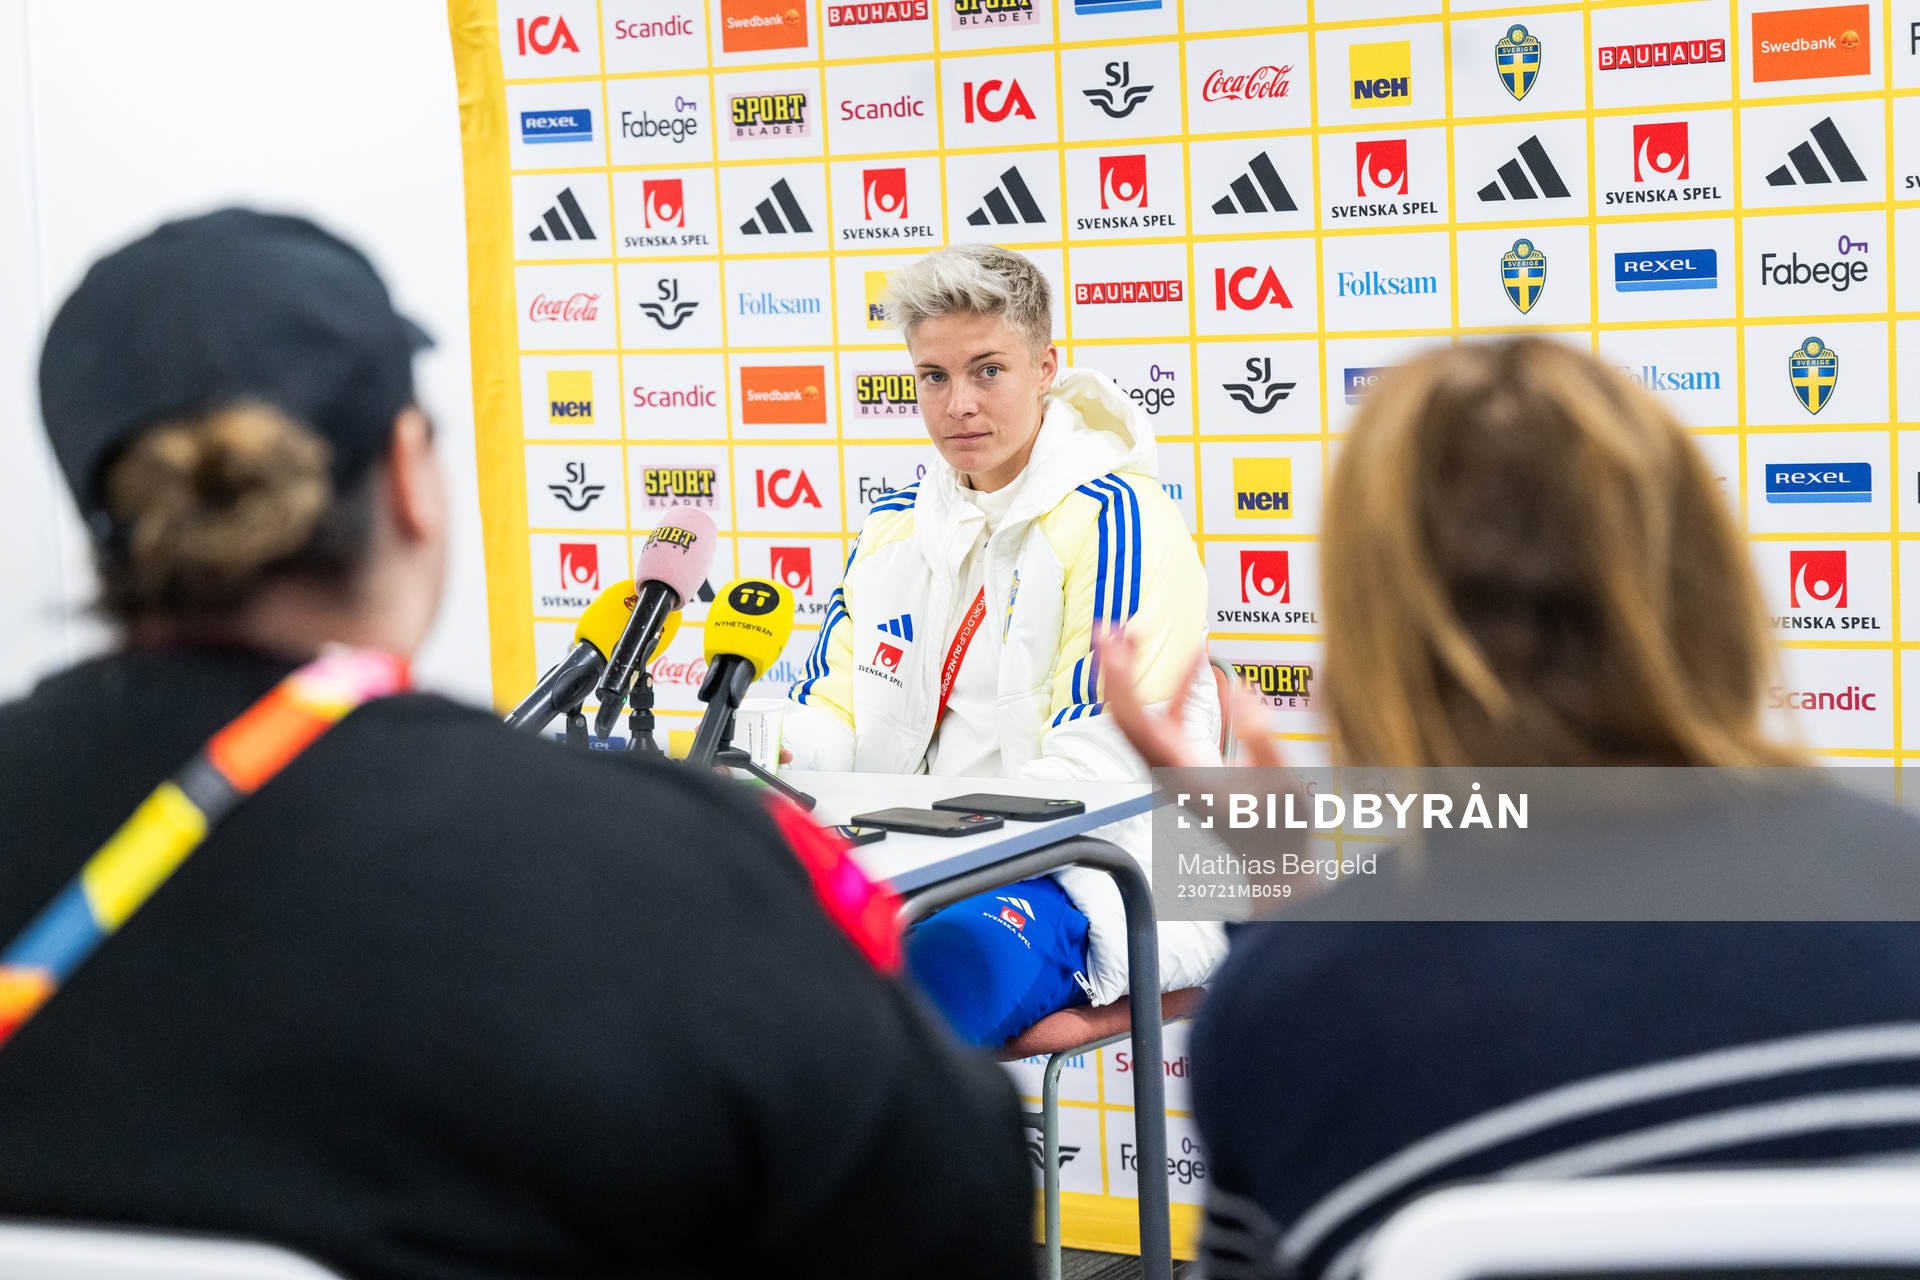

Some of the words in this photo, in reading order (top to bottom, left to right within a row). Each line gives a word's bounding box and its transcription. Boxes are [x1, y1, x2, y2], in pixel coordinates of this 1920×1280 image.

[727, 13, 783, 30] Swedbank
[829, 2, 927, 24] BAUHAUS
[959, 11, 1033, 25] BLADET
[517, 15, 580, 56] ICA
[615, 15, 694, 39] Scandic
[1502, 45, 1535, 54] SVERIGE
[1600, 40, 1724, 68] BAUHAUS
[1761, 35, 1837, 54] Swedbank
[1105, 61, 1130, 87] SJ
[1202, 64, 1295, 102] Coca-Cola
[732, 93, 807, 126] SPORT
[840, 95, 925, 121] Scandic
[963, 78, 1037, 123] ICA
[621, 110, 698, 143] Fabege
[736, 124, 806, 136] BLADET
[1605, 188, 1678, 205] SVENSKA
[1683, 186, 1721, 201] SPEL
[1077, 216, 1139, 230] SVENSKA
[1143, 214, 1175, 227] SPEL
[1331, 204, 1398, 218] SVENSKA
[1402, 202, 1438, 215] SPEL
[625, 235, 679, 248] SVENSKA
[682, 234, 709, 246] SPEL
[843, 227, 901, 240] SVENSKA
[904, 225, 934, 237] SPEL
[1507, 259, 1539, 268] SVERIGE
[1761, 252, 1868, 291] Fabege
[658, 279, 678, 301] SJ
[1076, 280, 1182, 304] BAUHAUS
[1215, 265, 1294, 311] ICA
[1338, 271, 1437, 297] Folksam
[739, 291, 821, 316] Folksam
[1246, 356, 1270, 383] SJ
[1796, 357, 1830, 367] SVERIGE
[856, 374, 919, 405] SPOR
[1616, 365, 1720, 391] lksam
[633, 385, 717, 408] Scandic
[747, 388, 802, 402] Swedbank
[861, 406, 919, 415] BLADE
[566, 462, 586, 483] SJ
[644, 467, 716, 499] SPORT
[756, 468, 822, 508] ICA
[649, 497, 714, 507] BLADET
[648, 526, 698, 550] PORT
[1217, 610, 1280, 623] SVENSKA
[1285, 611, 1319, 624] SPEL
[1771, 617, 1836, 630] VENSKA
[1841, 616, 1880, 630] SPEL
[652, 657, 706, 686] Coca-Co
[858, 664, 889, 681] SVENSKA
[889, 677, 904, 688] SPEL
[1260, 697, 1311, 708] ADET
[1768, 686, 1877, 711] Scandic
[982, 912, 1017, 934] SVENSKA
[1017, 933, 1032, 949] SPEL
[1120, 1143, 1207, 1185] Fege
